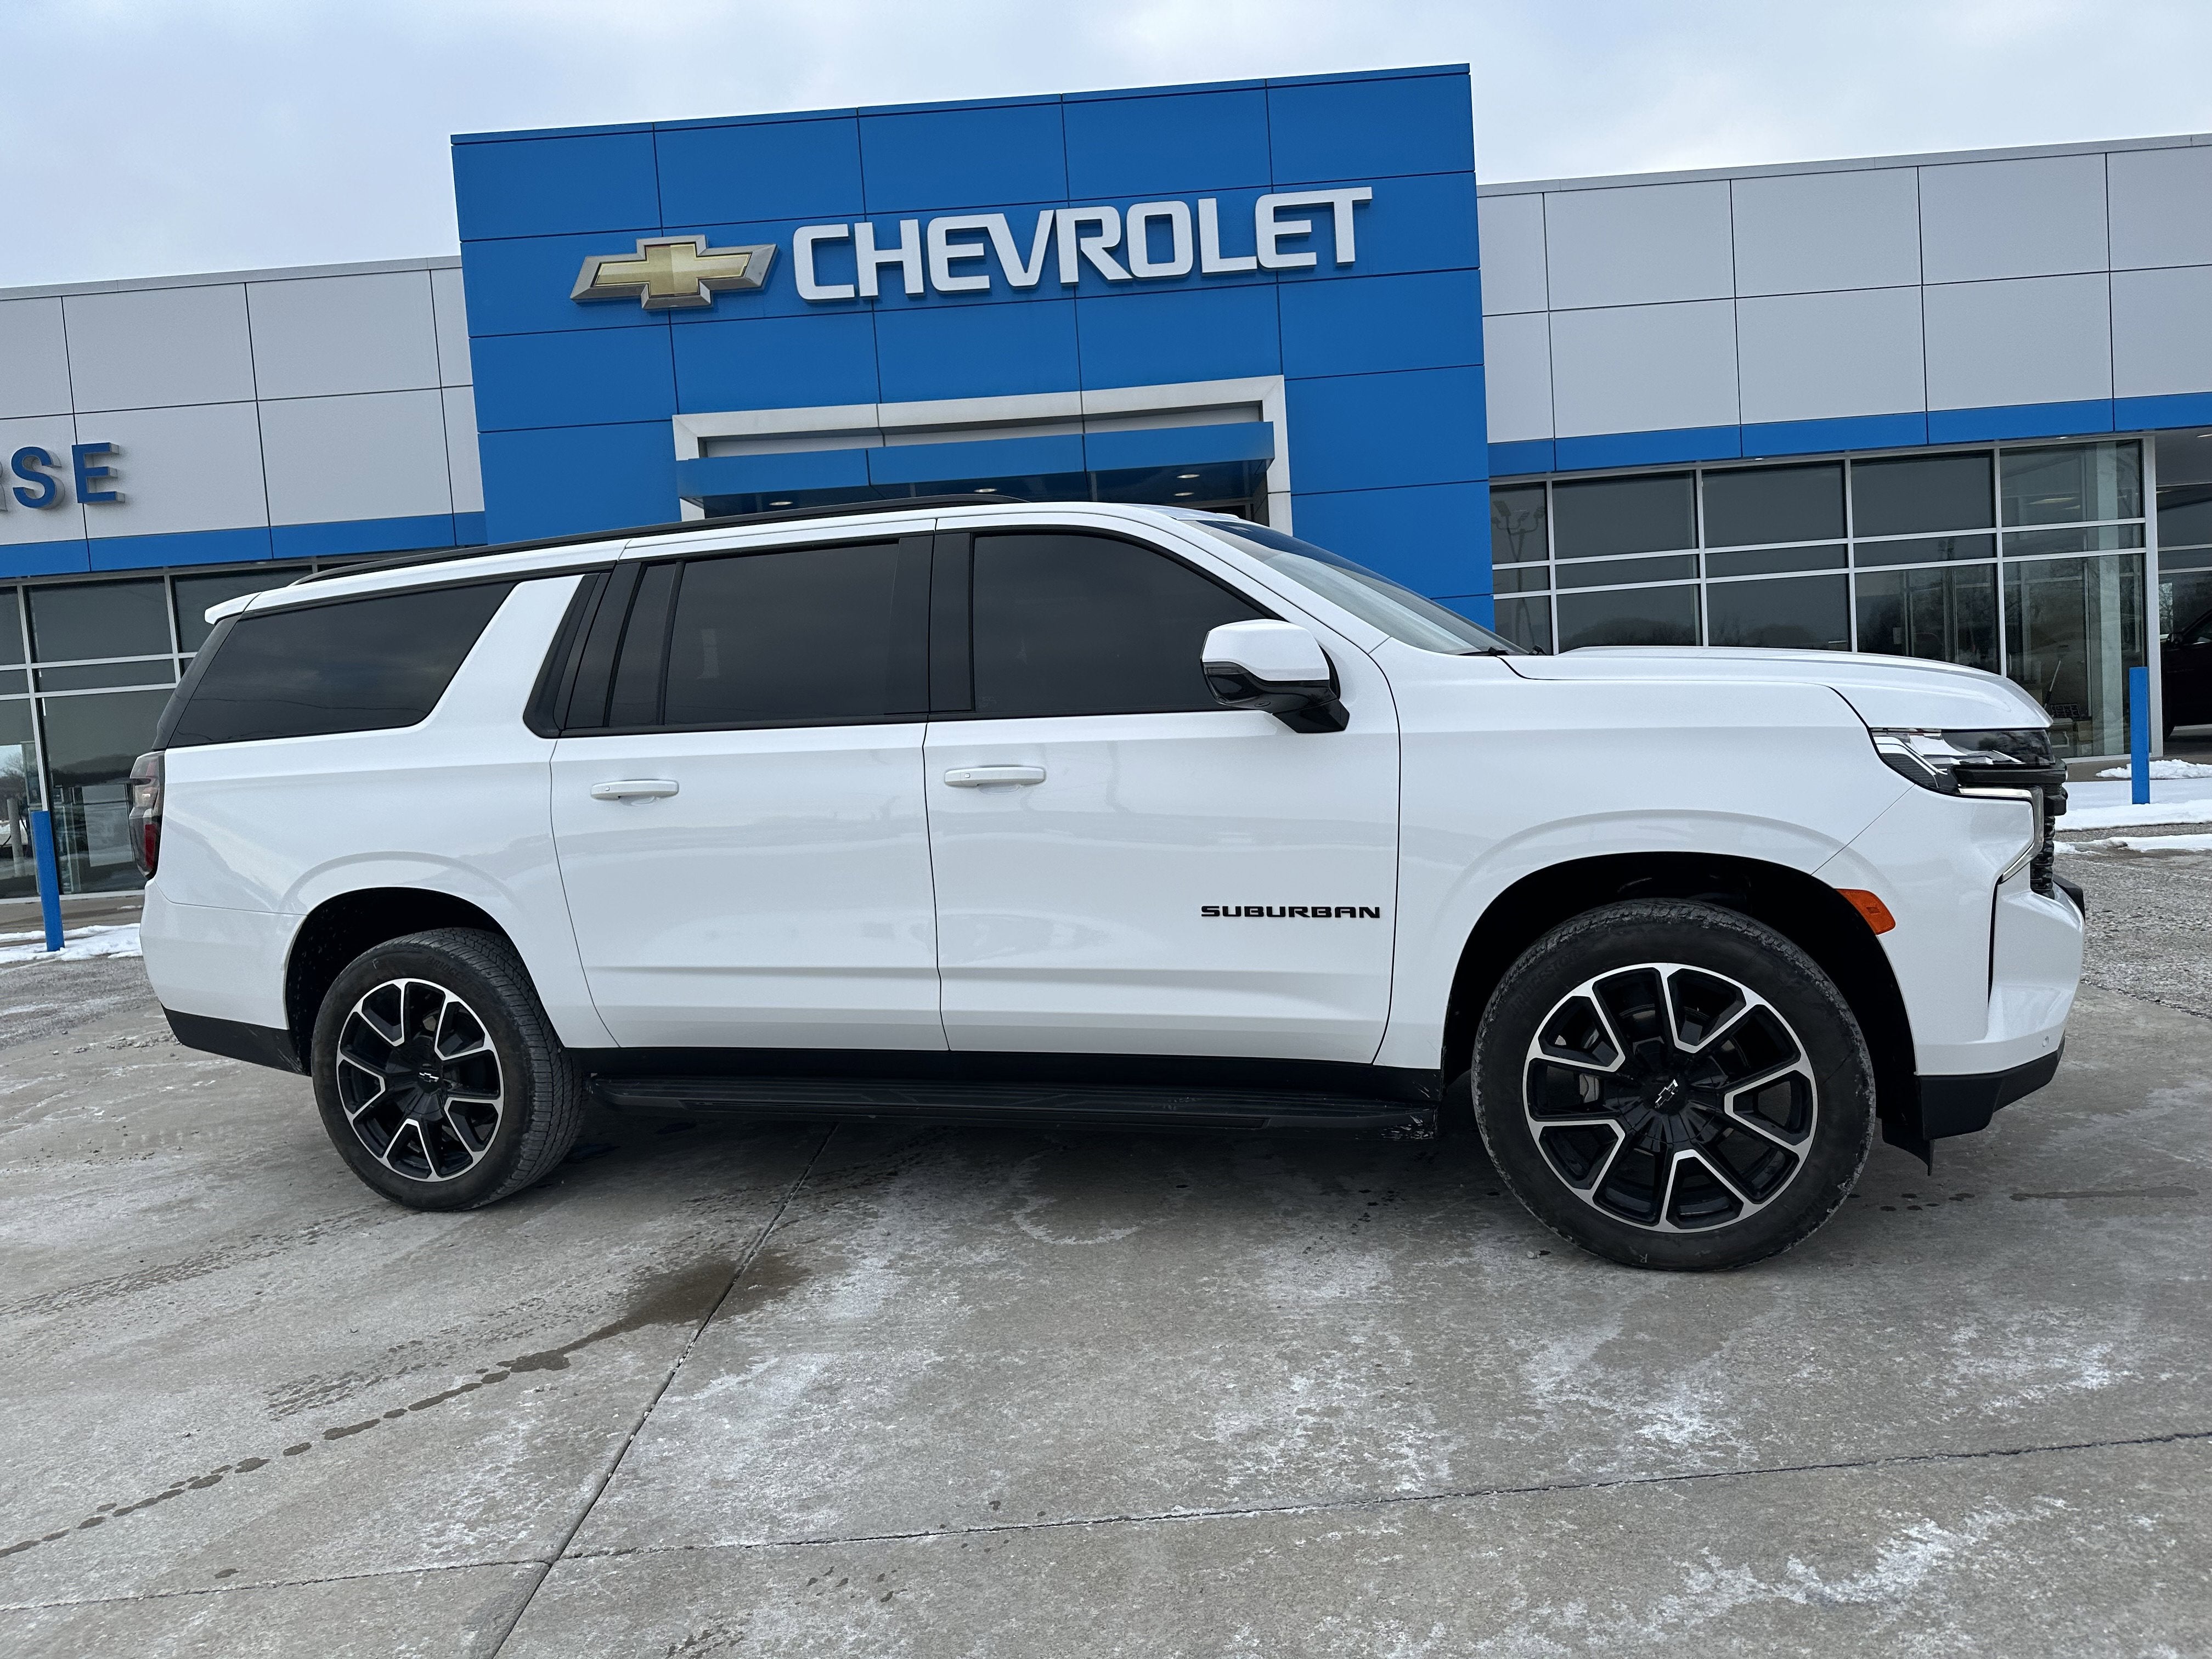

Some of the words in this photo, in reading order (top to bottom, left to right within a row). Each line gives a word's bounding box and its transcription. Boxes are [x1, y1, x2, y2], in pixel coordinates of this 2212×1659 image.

[792, 186, 1373, 303] CHEVROLET
[0, 442, 125, 511] SE
[1201, 905, 1380, 918] SUBURBAN
[1639, 1253, 1648, 1263] R
